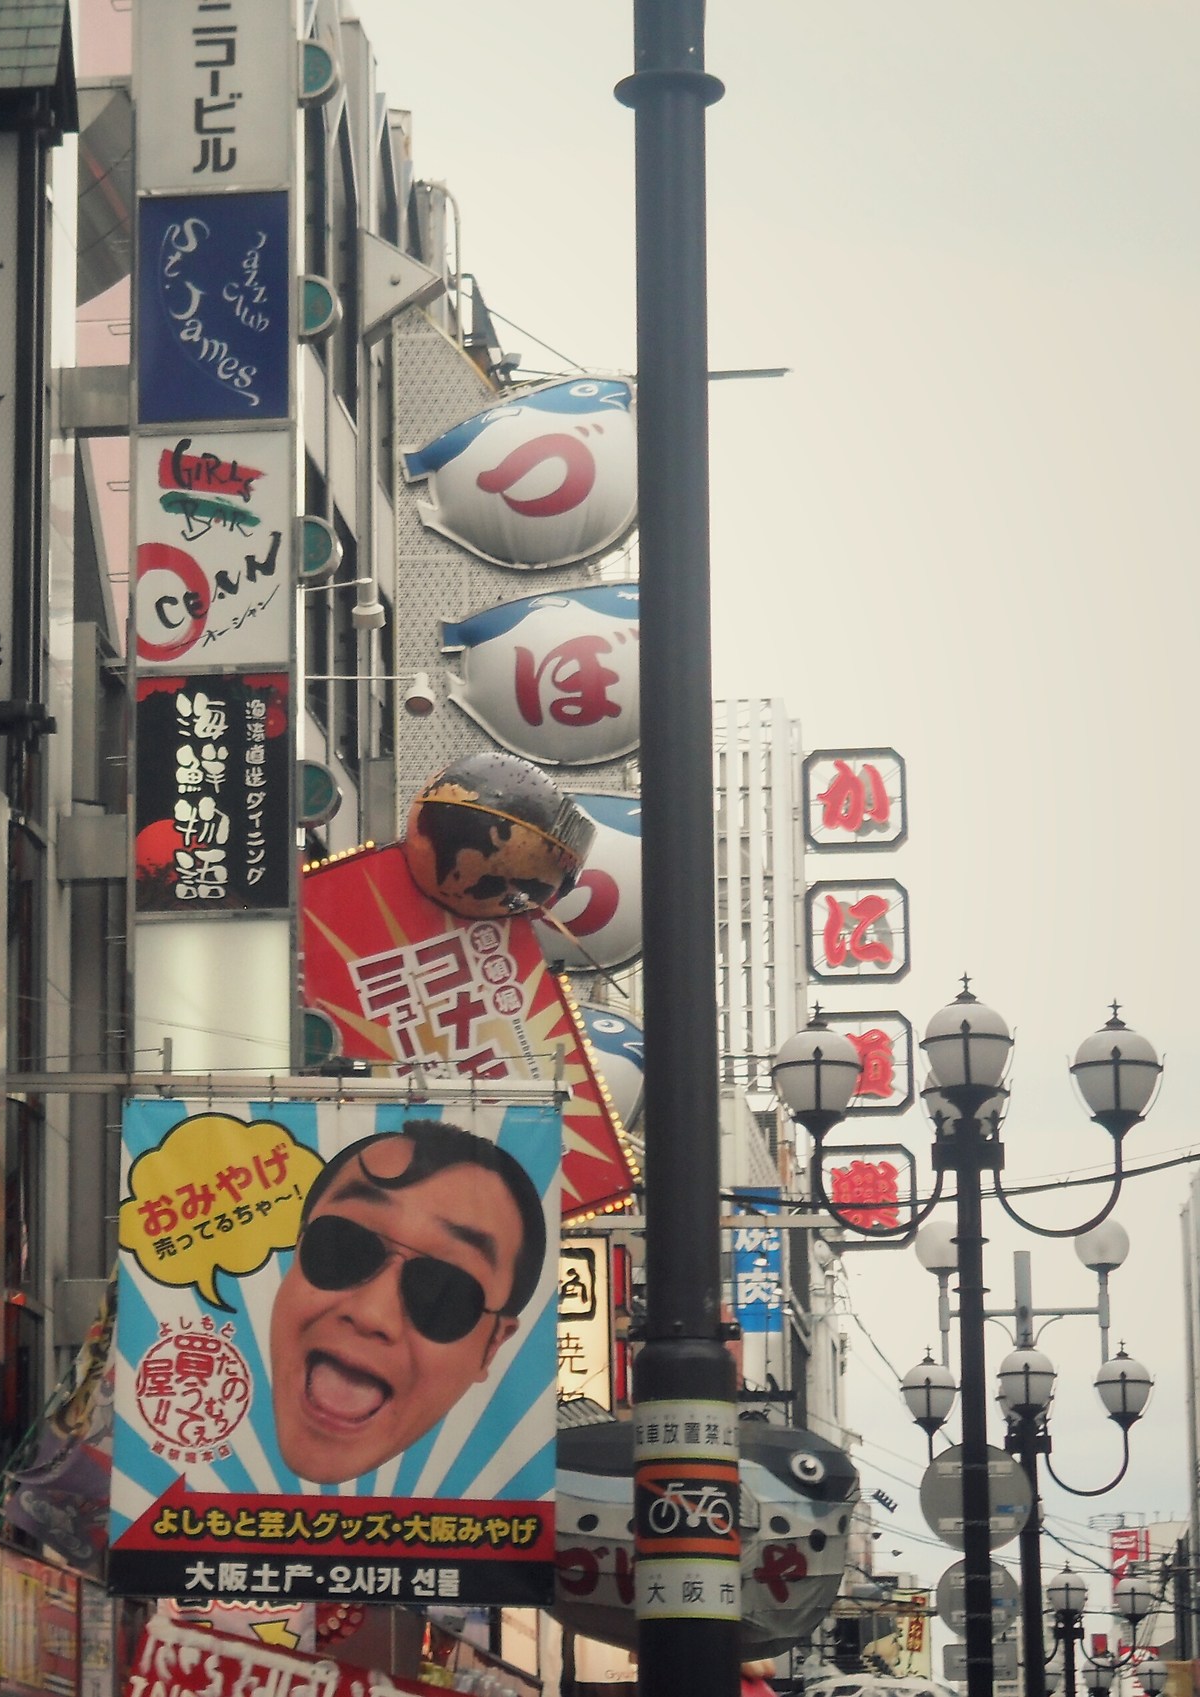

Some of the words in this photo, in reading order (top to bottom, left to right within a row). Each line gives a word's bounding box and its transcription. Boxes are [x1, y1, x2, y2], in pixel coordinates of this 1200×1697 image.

[174, 692, 230, 900] 海鮮物語
[138, 1142, 292, 1237] おみやげ
[159, 1315, 235, 1339] よしもと
[647, 1581, 736, 1605] 大阪市
